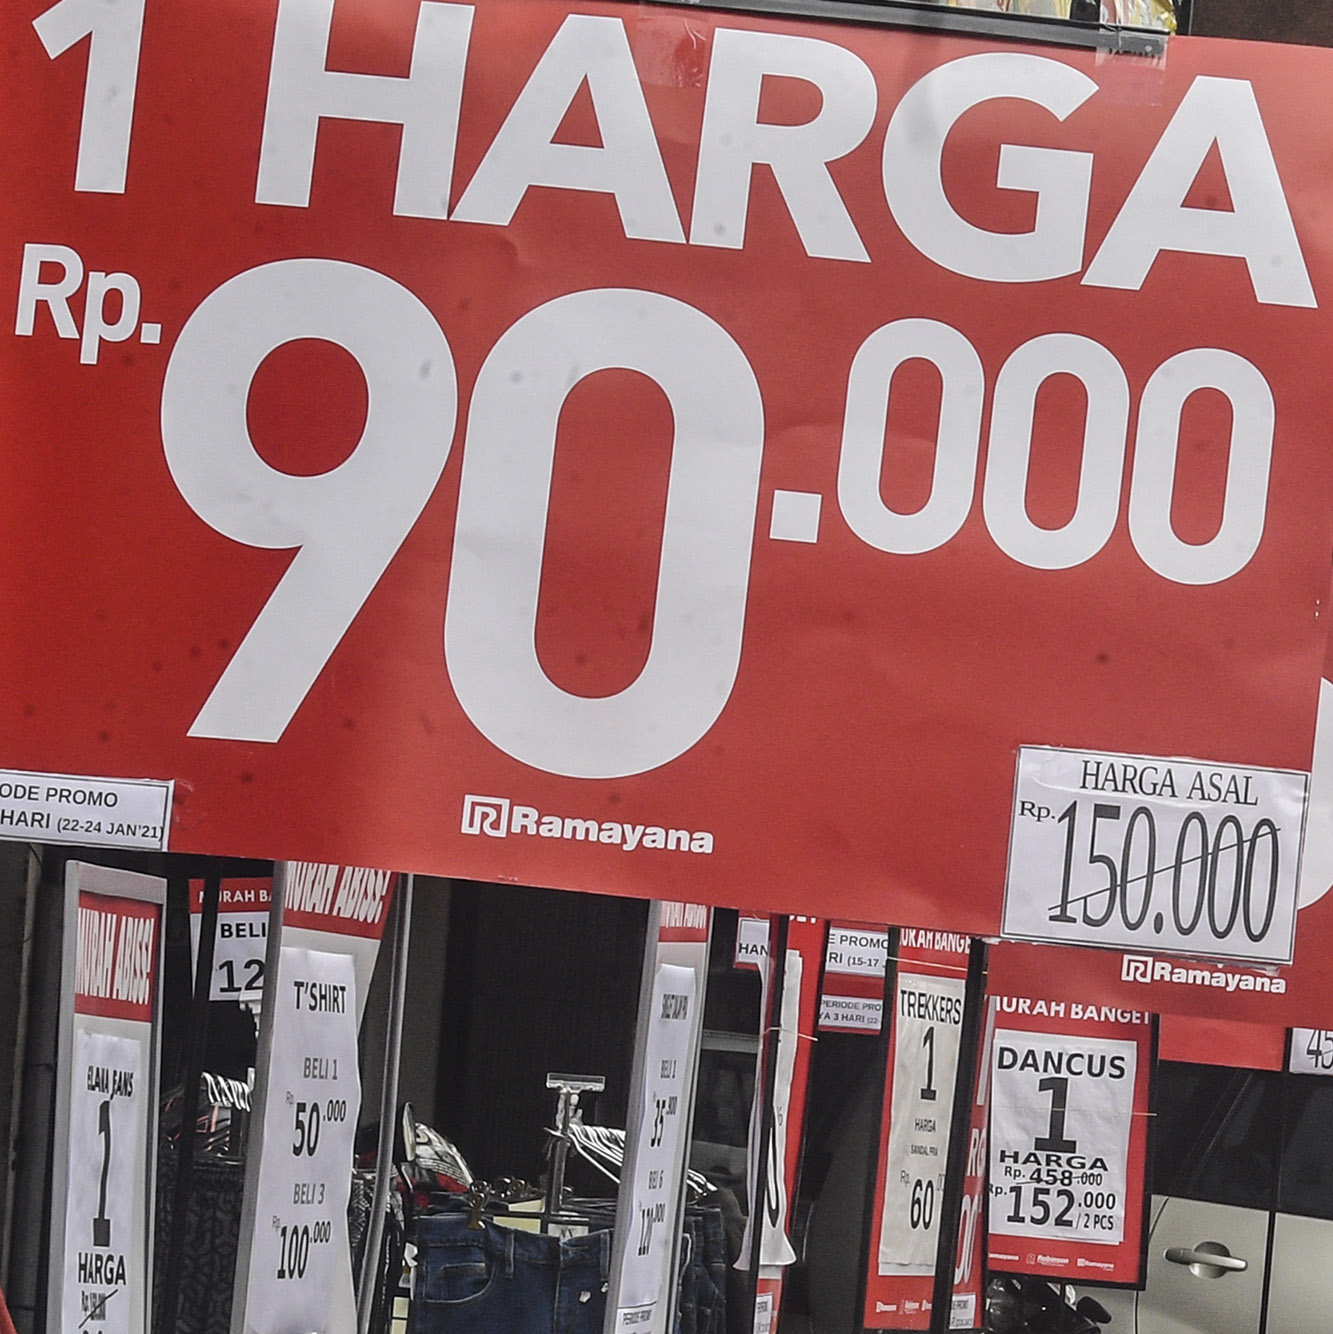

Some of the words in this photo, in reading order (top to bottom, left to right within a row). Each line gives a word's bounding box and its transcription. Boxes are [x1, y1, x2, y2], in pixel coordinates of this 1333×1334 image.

[32, 0, 147, 194] 1
[254, 0, 1318, 310] HARGA
[14, 242, 162, 366] Rp.
[46, 787, 118, 808] PROMO
[1080, 759, 1178, 798] HARGA
[1187, 771, 1258, 806] ASAL
[510, 805, 715, 855] Ramayana
[1019, 800, 1056, 822] Rp.
[1049, 800, 1281, 943] 150.000
[221, 922, 266, 939] BELI
[900, 928, 934, 948] URAH
[1154, 961, 1287, 994] Ramayana
[294, 981, 346, 1014] T'SHIRT
[900, 989, 962, 1025] TREKKERS
[303, 1057, 328, 1080] BELI
[332, 1059, 338, 1081] 1
[921, 1026, 937, 1101] 1
[997, 1046, 1126, 1080] DANCUS
[915, 1117, 937, 1133] HARGA
[1034, 1077, 1077, 1154] 1
[93, 1099, 111, 1248] 1
[999, 1149, 1109, 1172] HARGA
[1004, 1166, 1026, 1180] Rp.
[318, 1183, 325, 1205] 3
[1006, 1185, 1116, 1228] 152.000
[1093, 1214, 1114, 1230] PCS
[78, 1252, 126, 1286] HARGA
